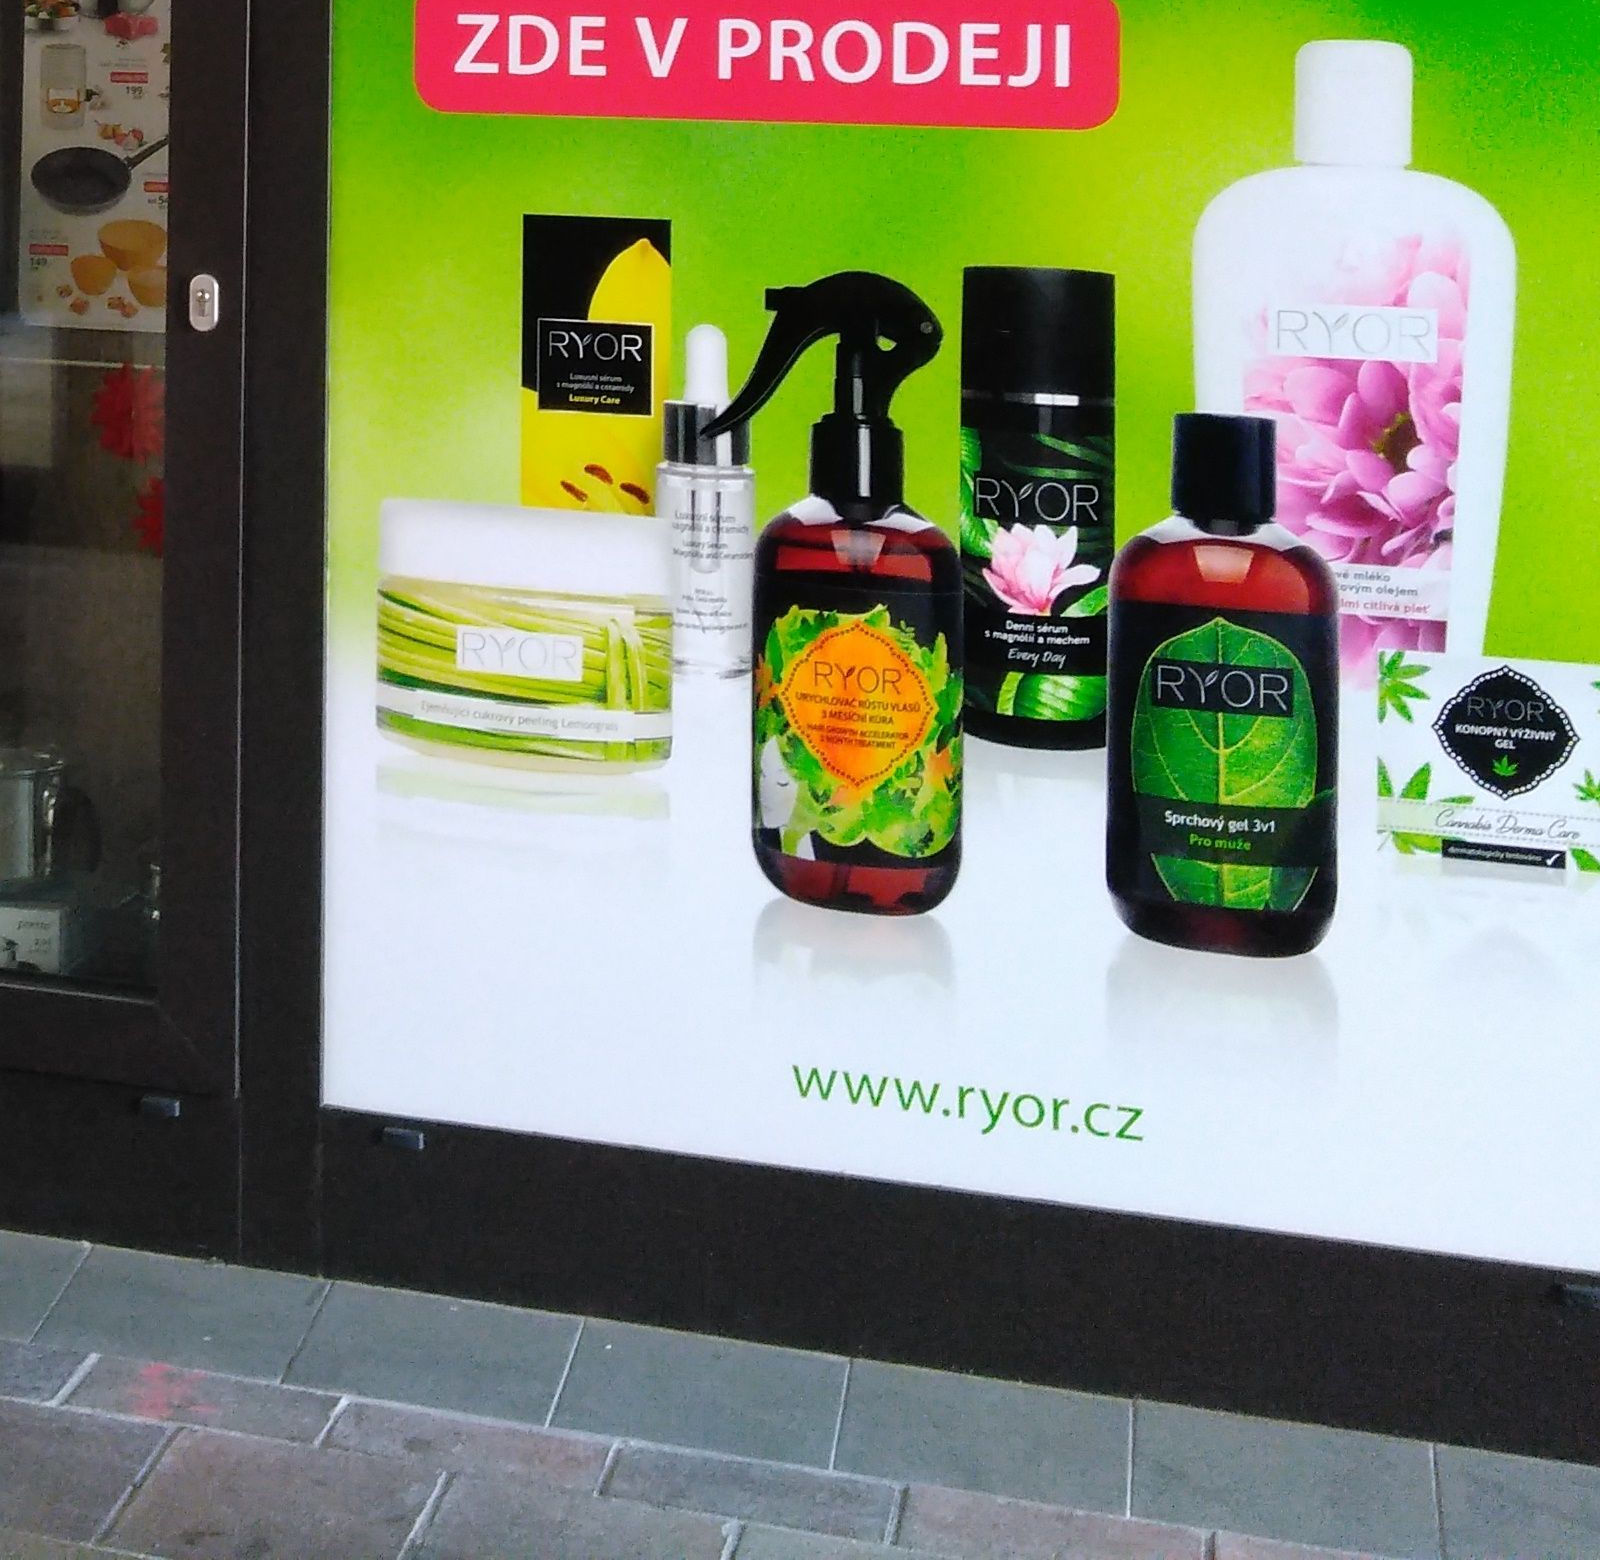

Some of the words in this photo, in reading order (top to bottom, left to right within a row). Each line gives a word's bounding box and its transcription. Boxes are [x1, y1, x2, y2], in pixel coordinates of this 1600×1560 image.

[454, 12, 608, 78] ZDE
[634, 17, 691, 79] V
[717, 17, 1075, 89] PRODEJI
[548, 330, 643, 362] RYOR
[1276, 309, 1431, 356] RYOR
[568, 393, 600, 405] Luxury
[600, 394, 621, 405] Care
[975, 476, 1100, 522] RYOR
[1375, 585, 1418, 598] olejem
[1005, 618, 1035, 632] Denní
[1036, 621, 1069, 634] sérum
[460, 631, 578, 675] RYOR
[1007, 648, 1039, 668] Every
[1041, 651, 1067, 670] Day
[813, 660, 902, 695] RYOR
[1157, 664, 1288, 711] RYOR
[1466, 695, 1545, 723] RYOR
[1494, 738, 1517, 750] GEL
[1164, 809, 1225, 832] Sprchový
[1227, 816, 1250, 833] gel
[1252, 818, 1276, 833] 3v1
[1189, 833, 1212, 847] Pro
[1214, 835, 1252, 850] muže
[791, 1063, 1145, 1142] www.ryor.cz
